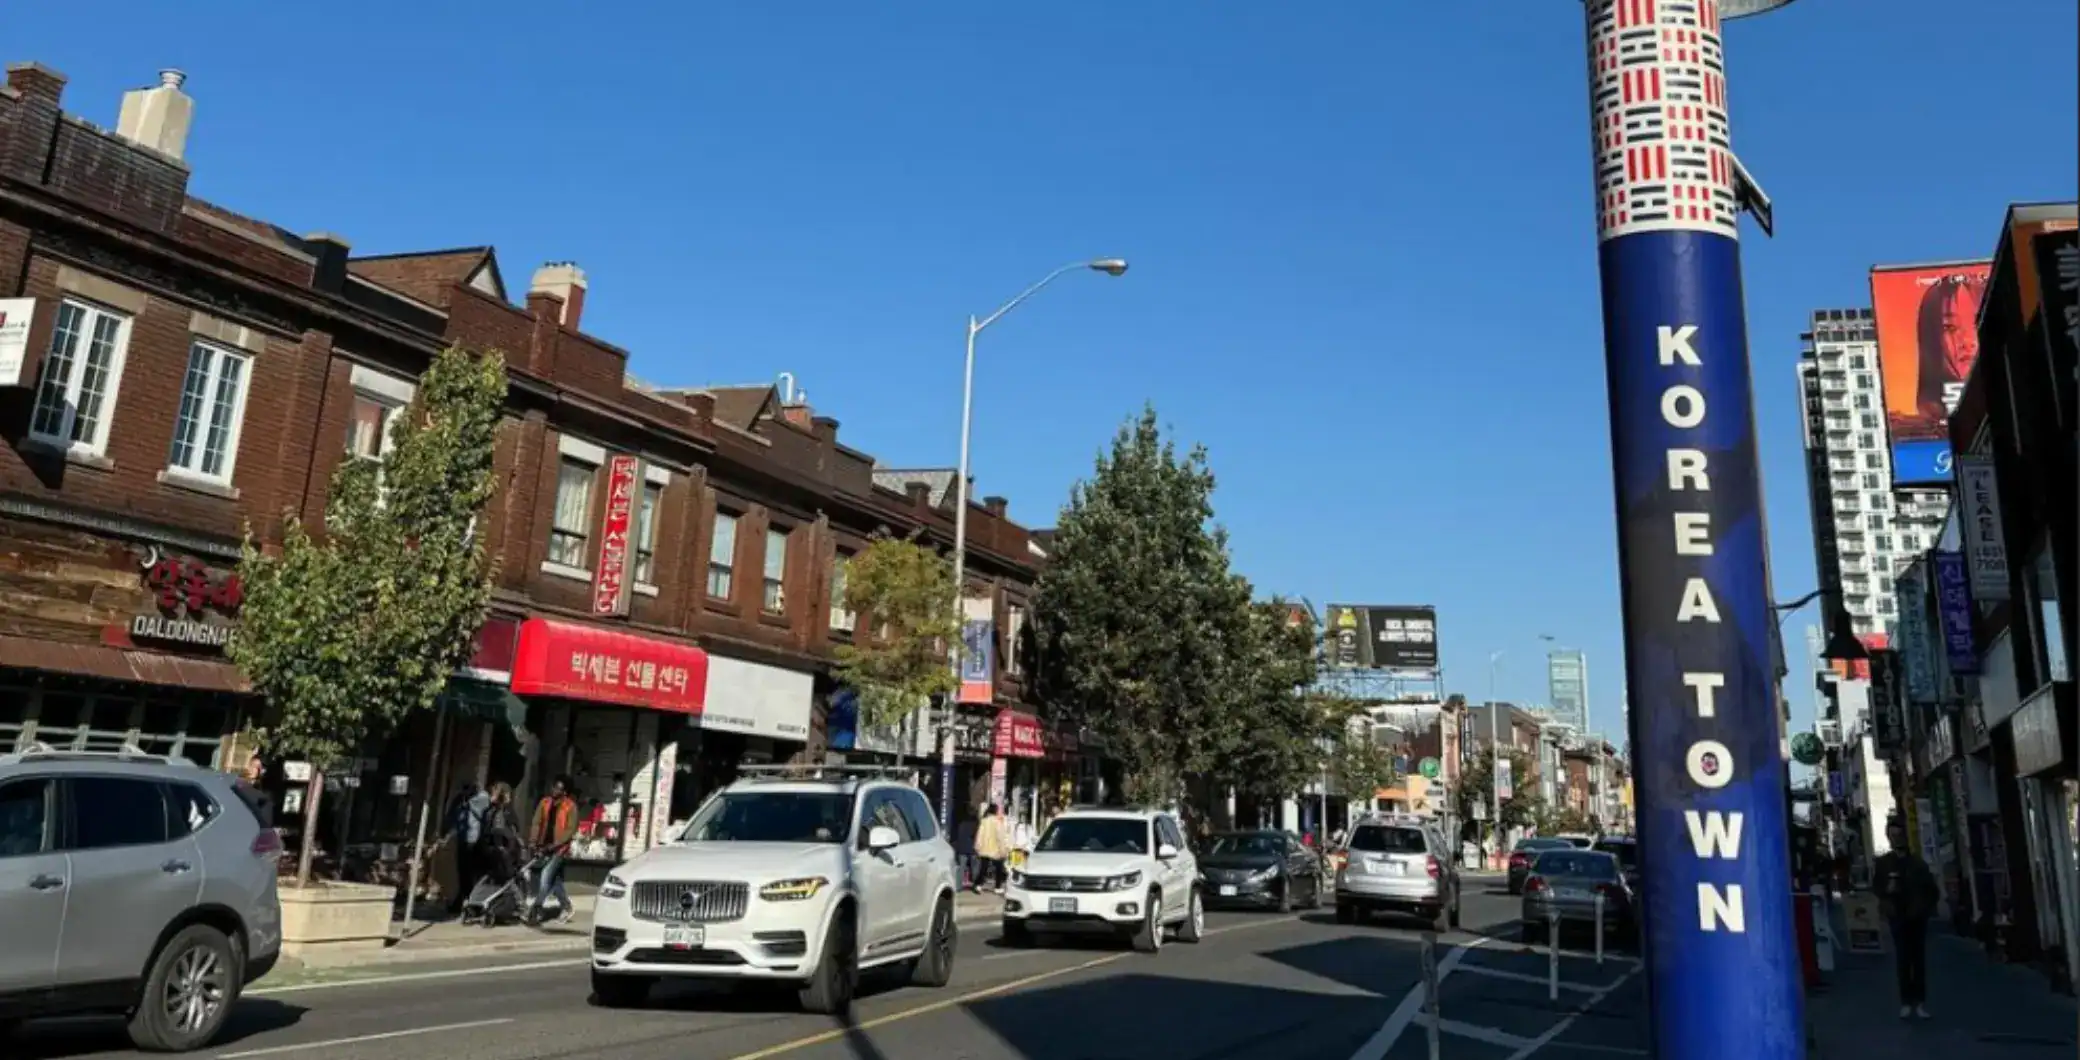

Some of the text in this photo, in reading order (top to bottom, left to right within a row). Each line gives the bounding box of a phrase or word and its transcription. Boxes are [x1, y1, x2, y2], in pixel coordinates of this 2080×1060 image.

[1975, 479, 1995, 542] LEASE
[1656, 325, 1746, 933] KOREA TOWN
[571, 651, 621, 685] 빅세븐
[625, 659, 657, 690] 선물
